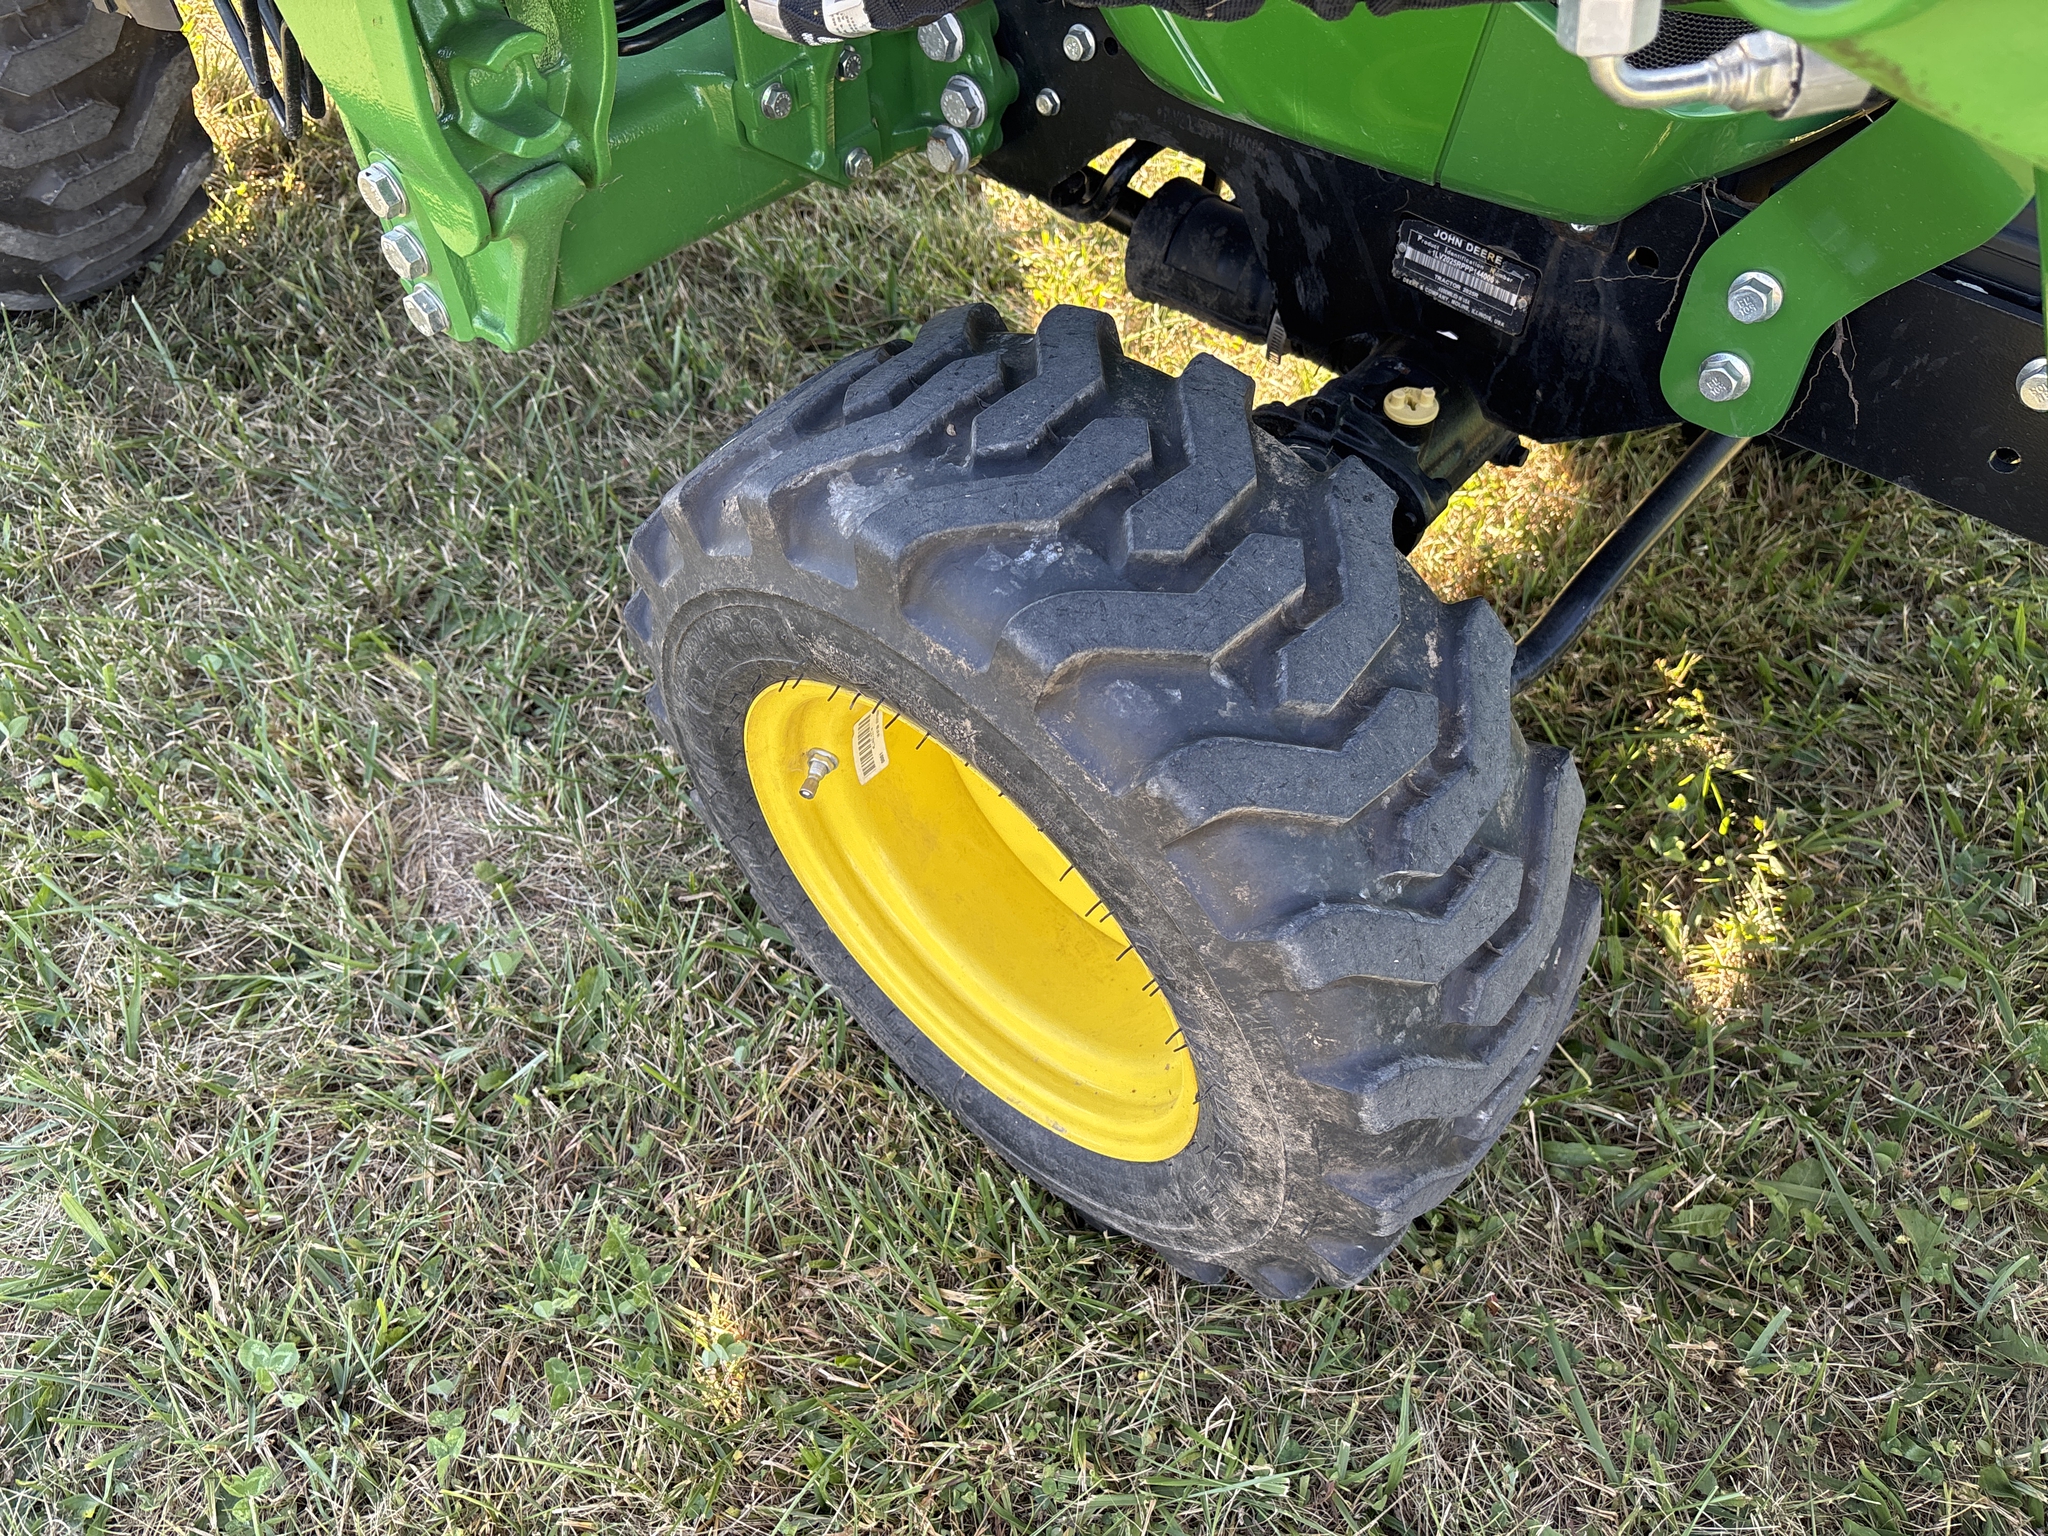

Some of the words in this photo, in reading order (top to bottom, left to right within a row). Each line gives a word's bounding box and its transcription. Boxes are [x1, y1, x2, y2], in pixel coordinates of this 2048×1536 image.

[1417, 234, 1440, 251] Product
[1445, 248, 1485, 269] Identification
[1489, 267, 1514, 283] Number
[1433, 229, 1463, 248] JOHN
[1466, 242, 1503, 265] DEERE
[1434, 274, 1461, 290] TRACTOR
